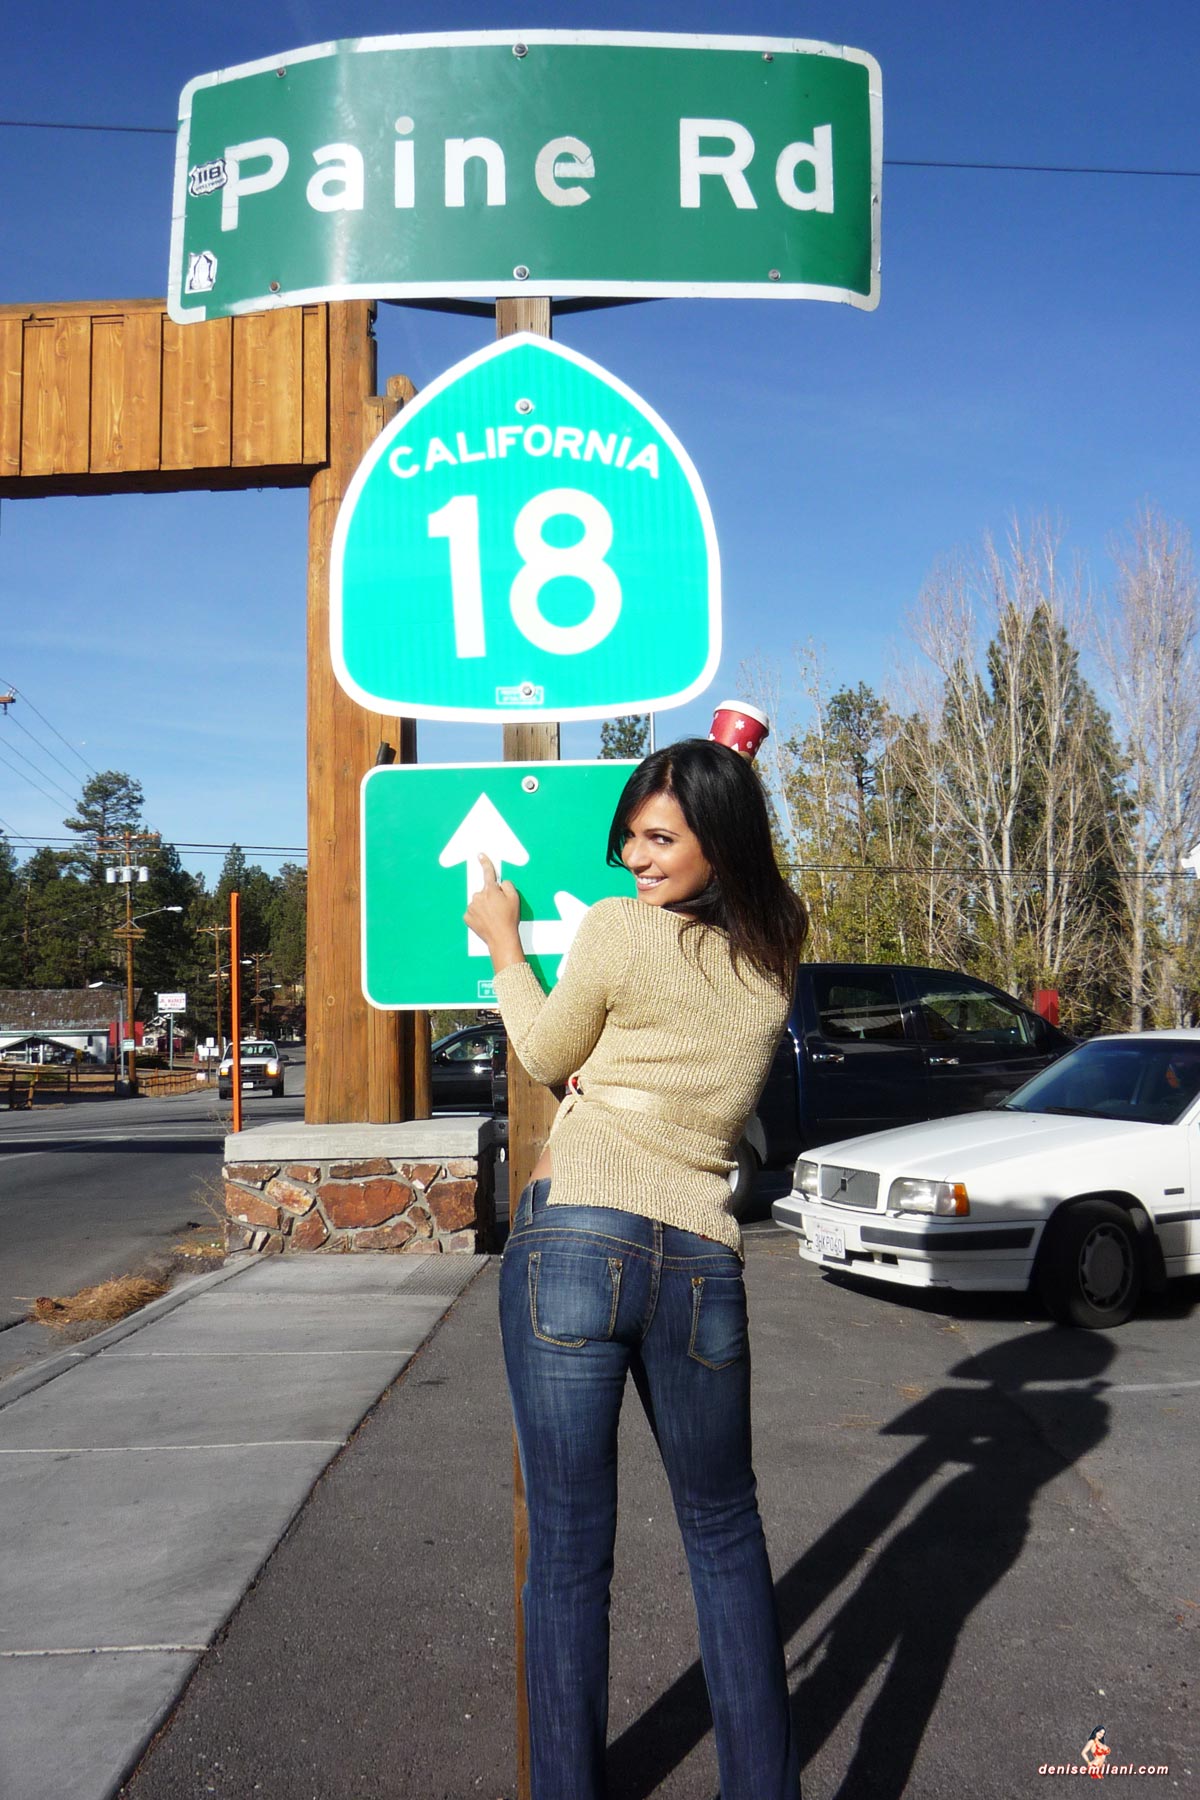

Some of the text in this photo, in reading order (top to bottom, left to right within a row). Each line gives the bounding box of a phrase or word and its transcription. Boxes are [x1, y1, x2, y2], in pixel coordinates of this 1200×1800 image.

[221, 115, 835, 232] Paine Rd
[388, 424, 659, 480] CALIFORNIA
[427, 487, 623, 659] 18
